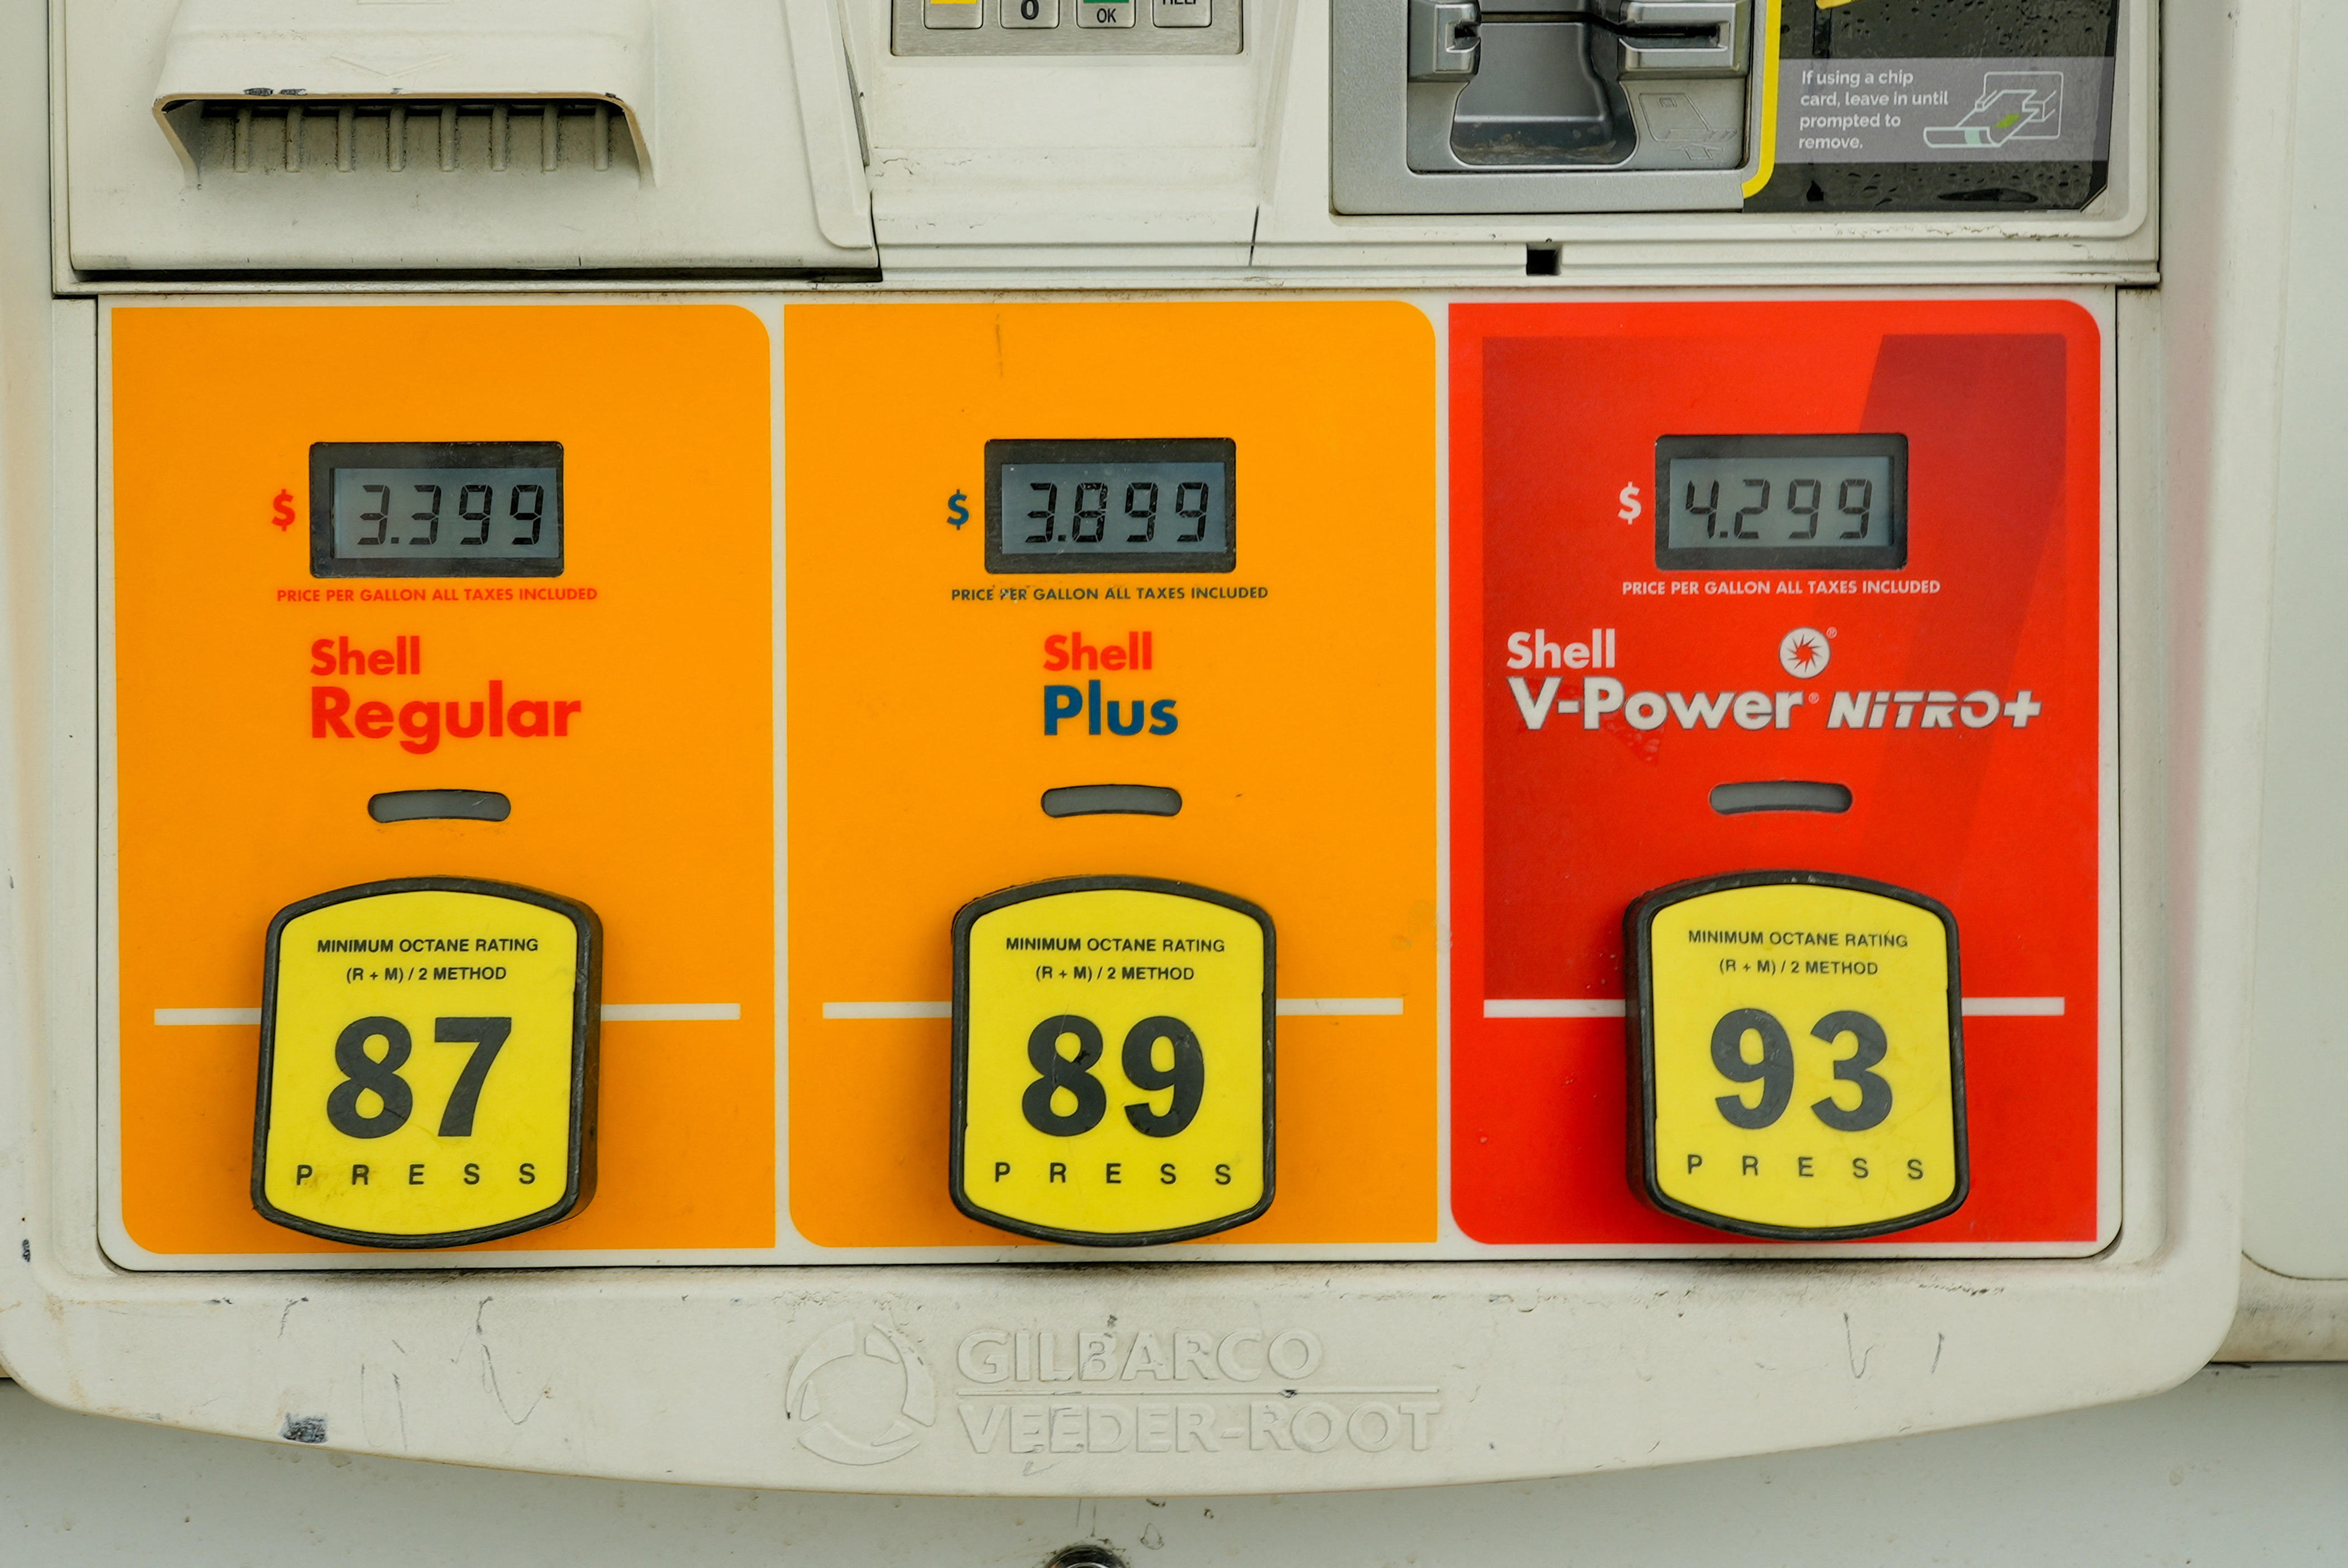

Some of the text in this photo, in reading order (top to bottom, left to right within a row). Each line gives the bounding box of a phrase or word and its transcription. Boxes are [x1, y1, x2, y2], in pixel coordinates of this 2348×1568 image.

[1096, 8, 1116, 23] OK
[1802, 69, 1914, 88] If using a chip
[1800, 90, 1948, 108] card, leave in until
[1800, 113, 1901, 131] prompted to
[1799, 137, 1863, 149] remove.
[271, 484, 544, 545] $ 3.399
[947, 482, 1209, 544] $ 3.899
[1618, 479, 1872, 540] $ 4.299
[277, 588, 598, 602] PRICE PER GALLON ALL TAXES INCLUDED
[952, 587, 1268, 601] PRICE PER GALLON ALL TAXES INCLUDED
[1622, 580, 1941, 595] PRICE PER GALLON ALL TAXES INCLUDED
[310, 635, 421, 676] Shell
[1043, 631, 1153, 672] Shell
[1506, 628, 1615, 669] Shell
[311, 679, 582, 756] Regular
[1044, 679, 1178, 736] Plus
[317, 938, 538, 953] MINIMUM OCTANE RATING
[1006, 937, 1225, 952] MINIMUM OCTANE RATING
[1689, 930, 1908, 947] MINIMUM OCTANE RATING
[433, 966, 506, 980] METHOD
[1121, 966, 1194, 980] METHOD
[1805, 961, 1878, 975] METHOD
[326, 1016, 512, 1140] 87
[1021, 1014, 1205, 1138] 89
[1710, 1008, 1893, 1132] 93
[296, 1162, 535, 1186] PRESS
[995, 1162, 1232, 1185] PRESS
[1687, 1154, 1924, 1180] PRESS
[957, 1329, 1322, 1383] GILBARCO
[958, 1400, 1440, 1454] VEEDER-ROOT
